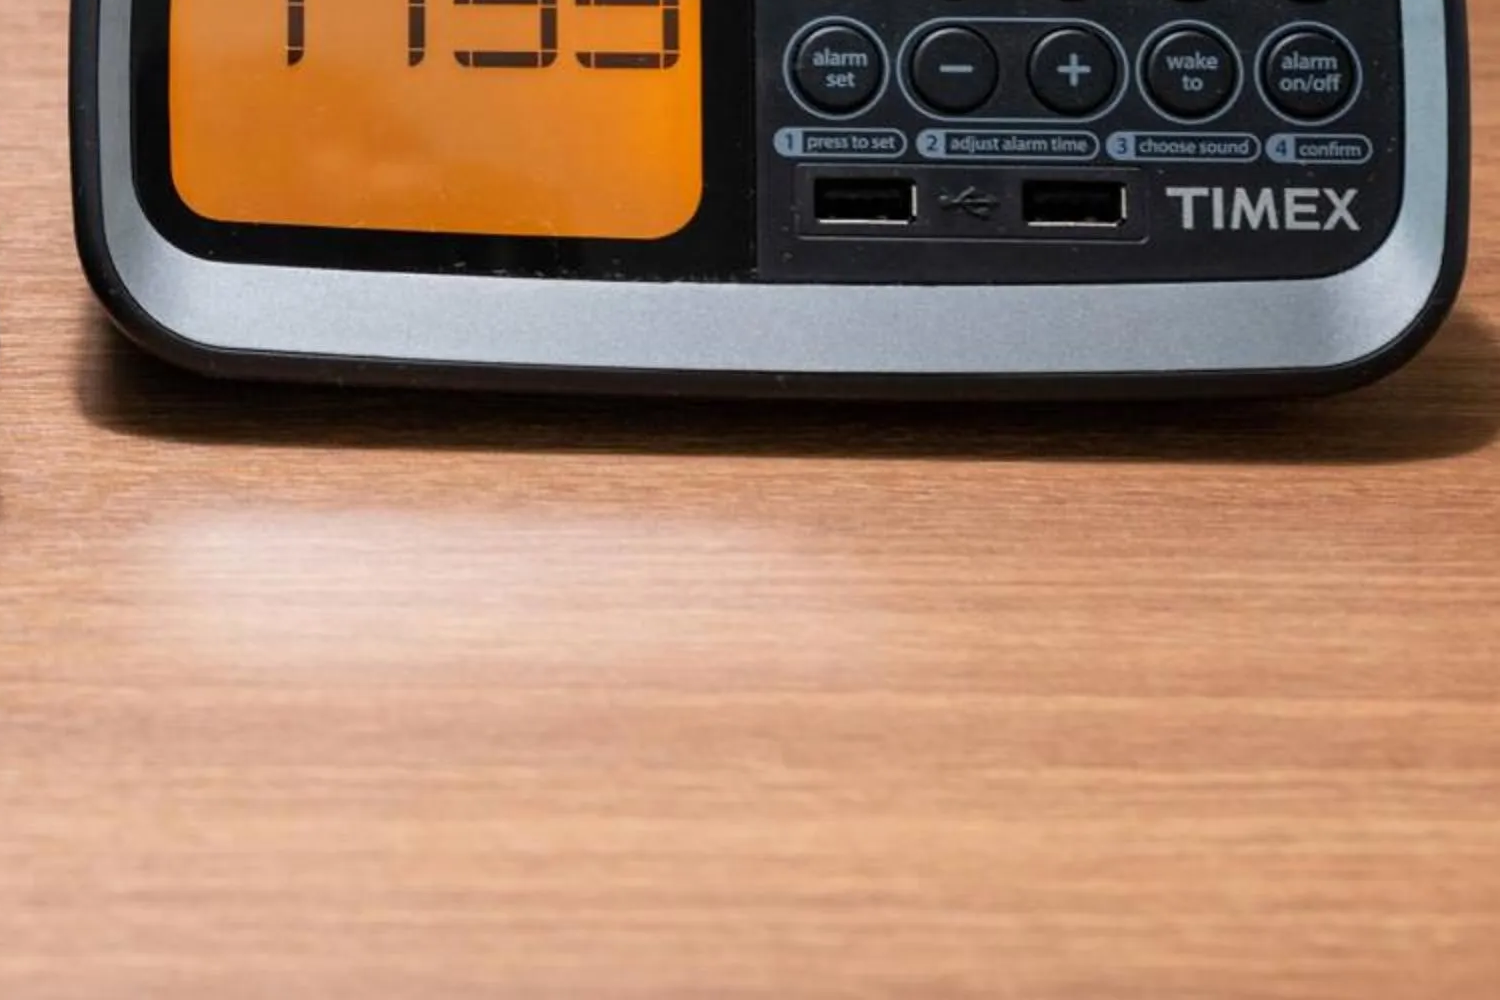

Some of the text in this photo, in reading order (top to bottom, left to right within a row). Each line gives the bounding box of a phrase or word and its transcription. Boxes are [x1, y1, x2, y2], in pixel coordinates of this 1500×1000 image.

[812, 48, 868, 67] alarm
[1166, 52, 1219, 70] wake
[1281, 51, 1338, 70] alarm
[825, 72, 856, 88] set
[1182, 74, 1204, 92] to
[1279, 74, 1342, 93] on/off
[806, 137, 849, 153] press
[851, 135, 869, 149] to
[871, 136, 896, 149] set
[950, 135, 999, 153] adjust
[1002, 135, 1048, 151] alarm
[1050, 135, 1088, 152] time
[1139, 138, 1196, 154] choose
[1199, 139, 1249, 155] sound
[1299, 141, 1362, 157] confirm
[1165, 187, 1361, 231] TIMEX
